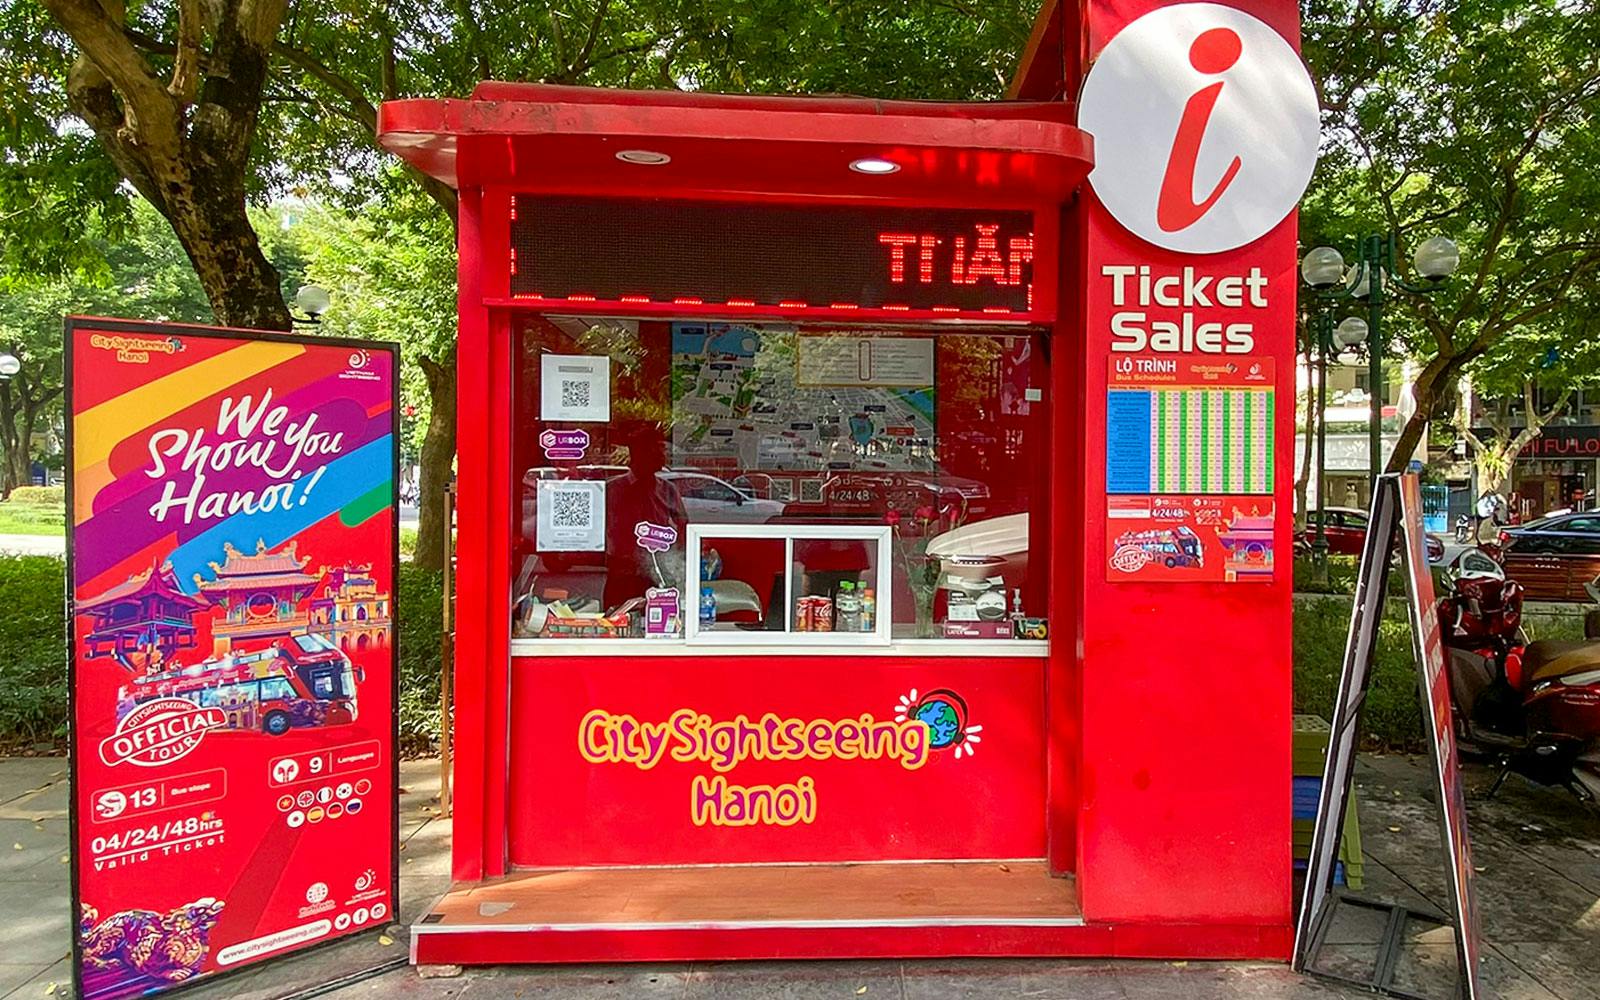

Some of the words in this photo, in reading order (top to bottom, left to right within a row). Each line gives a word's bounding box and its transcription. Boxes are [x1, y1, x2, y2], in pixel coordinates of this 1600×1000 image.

[1102, 265, 1268, 307] Ticket
[1111, 312, 1255, 353] Sales
[117, 350, 149, 363] Hanoi
[1116, 357, 1133, 375] LỘ
[1136, 357, 1176, 373] TRÌNH
[217, 388, 288, 435] We
[145, 427, 275, 478] Show
[264, 412, 344, 479] You
[149, 466, 327, 524] Hanoi!
[113, 710, 221, 757] OFFICIAL
[127, 701, 193, 728] CITYSIGHTSEEING
[149, 735, 197, 760] TOUR
[578, 709, 930, 771] CitySightseeing
[309, 756, 323, 774] 9
[129, 787, 157, 808] 13
[692, 775, 817, 826] Hanoi
[94, 851, 149, 871] Valid
[162, 835, 224, 855] Ticket
